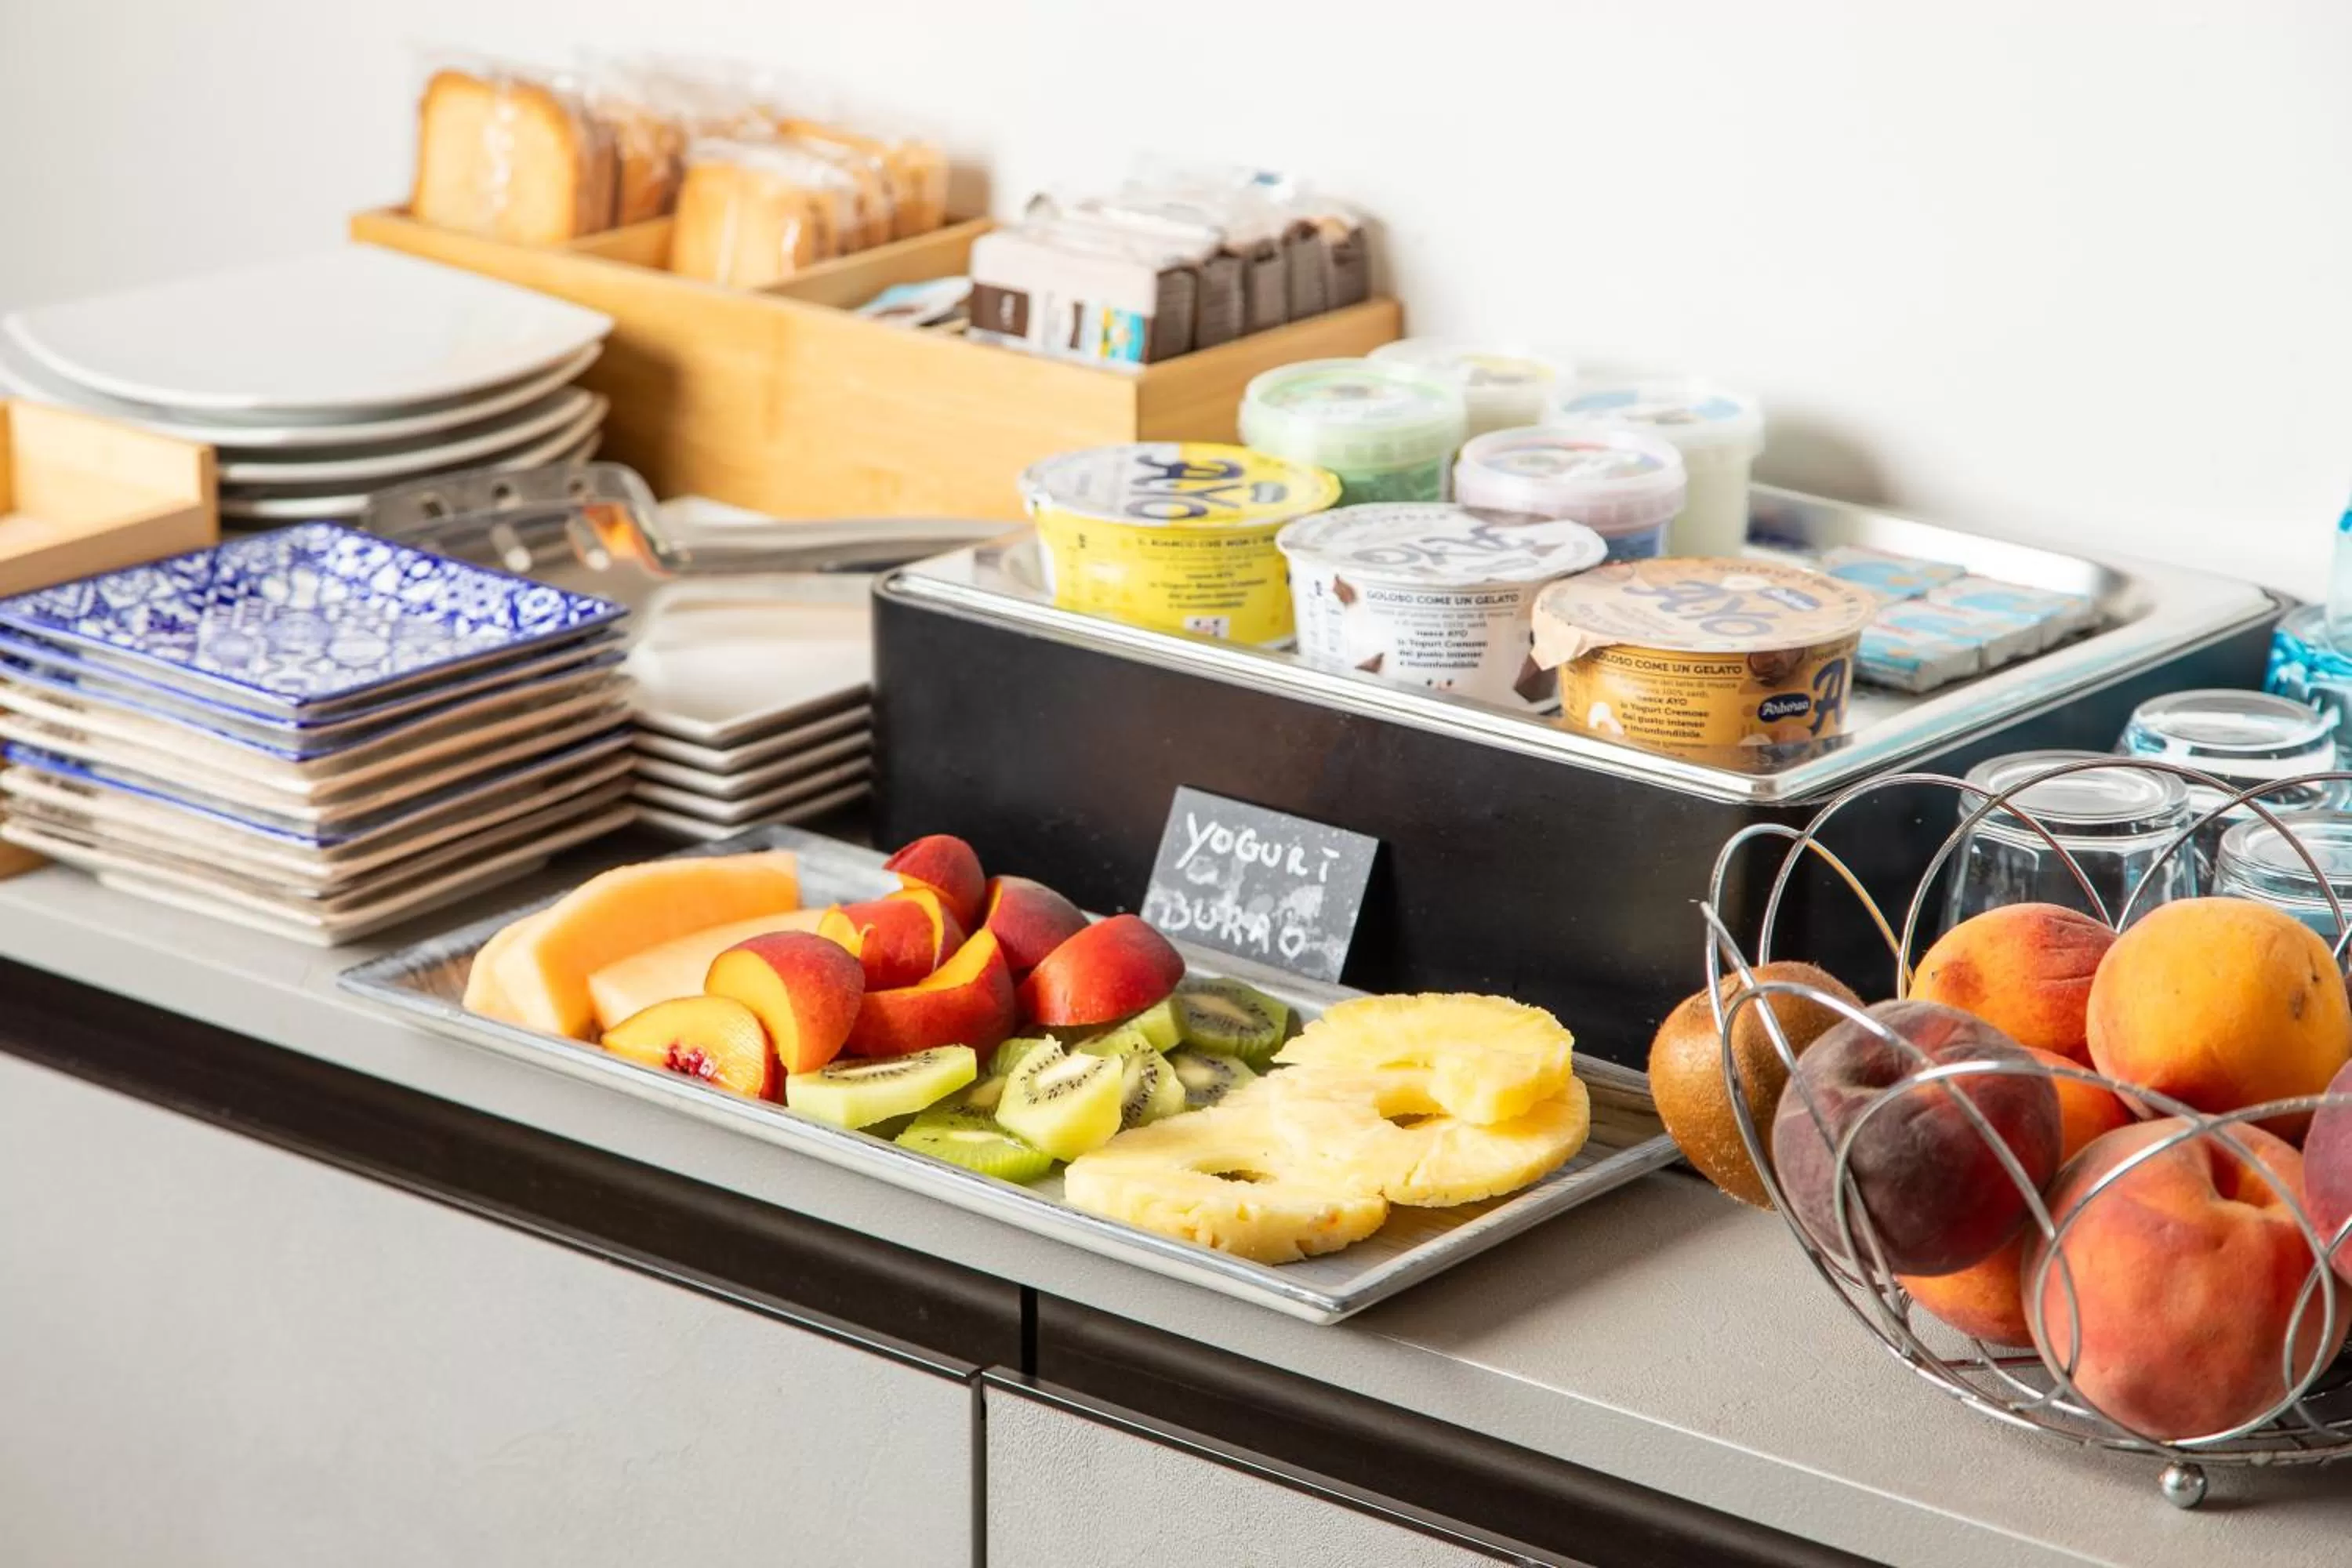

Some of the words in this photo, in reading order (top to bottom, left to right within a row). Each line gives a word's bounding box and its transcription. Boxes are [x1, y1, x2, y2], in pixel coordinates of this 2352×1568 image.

[1367, 590, 1413, 603] GOLOSO
[1417, 593, 1451, 605] COME
[1455, 594, 1473, 606] UN
[1475, 593, 1519, 606] GELATO
[1635, 659, 1669, 673] COME
[1672, 663, 1690, 674] UN
[1693, 665, 1742, 675] GELATO
[1630, 702, 1662, 714] Yogurt
[1664, 706, 1710, 717] Cremoso
[1176, 812, 1340, 883] YOGURT
